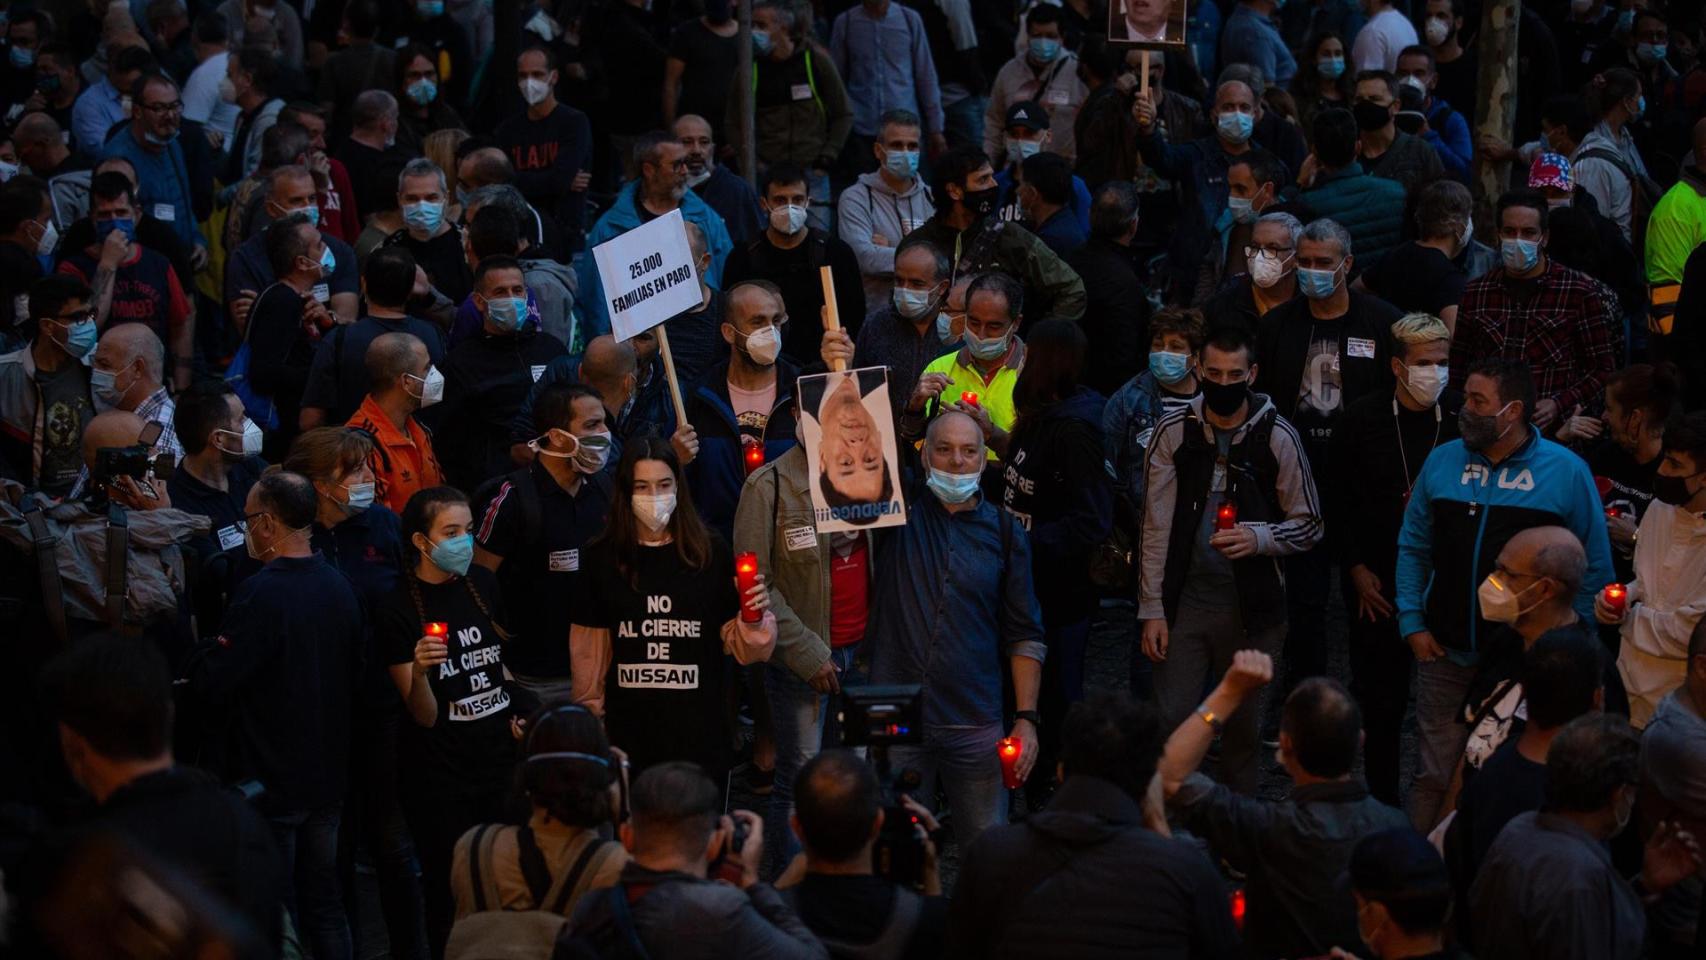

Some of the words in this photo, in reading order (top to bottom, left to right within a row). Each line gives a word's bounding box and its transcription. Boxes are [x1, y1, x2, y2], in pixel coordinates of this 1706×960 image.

[629, 252, 663, 279] 25.000
[612, 282, 654, 314] FAMILIAS
[654, 276, 667, 293] EN
[666, 264, 691, 287] PARO
[1461, 463, 1535, 491] FILA
[646, 594, 673, 614] NO
[457, 626, 482, 648] NO
[618, 620, 639, 638] AL
[641, 618, 702, 638] CIERRE
[439, 658, 460, 680] AL
[460, 644, 501, 671] CIERR
[647, 642, 671, 660] DE
[469, 671, 492, 692] DE
[620, 668, 696, 684] NISSAN
[453, 690, 510, 715] NISSAN
